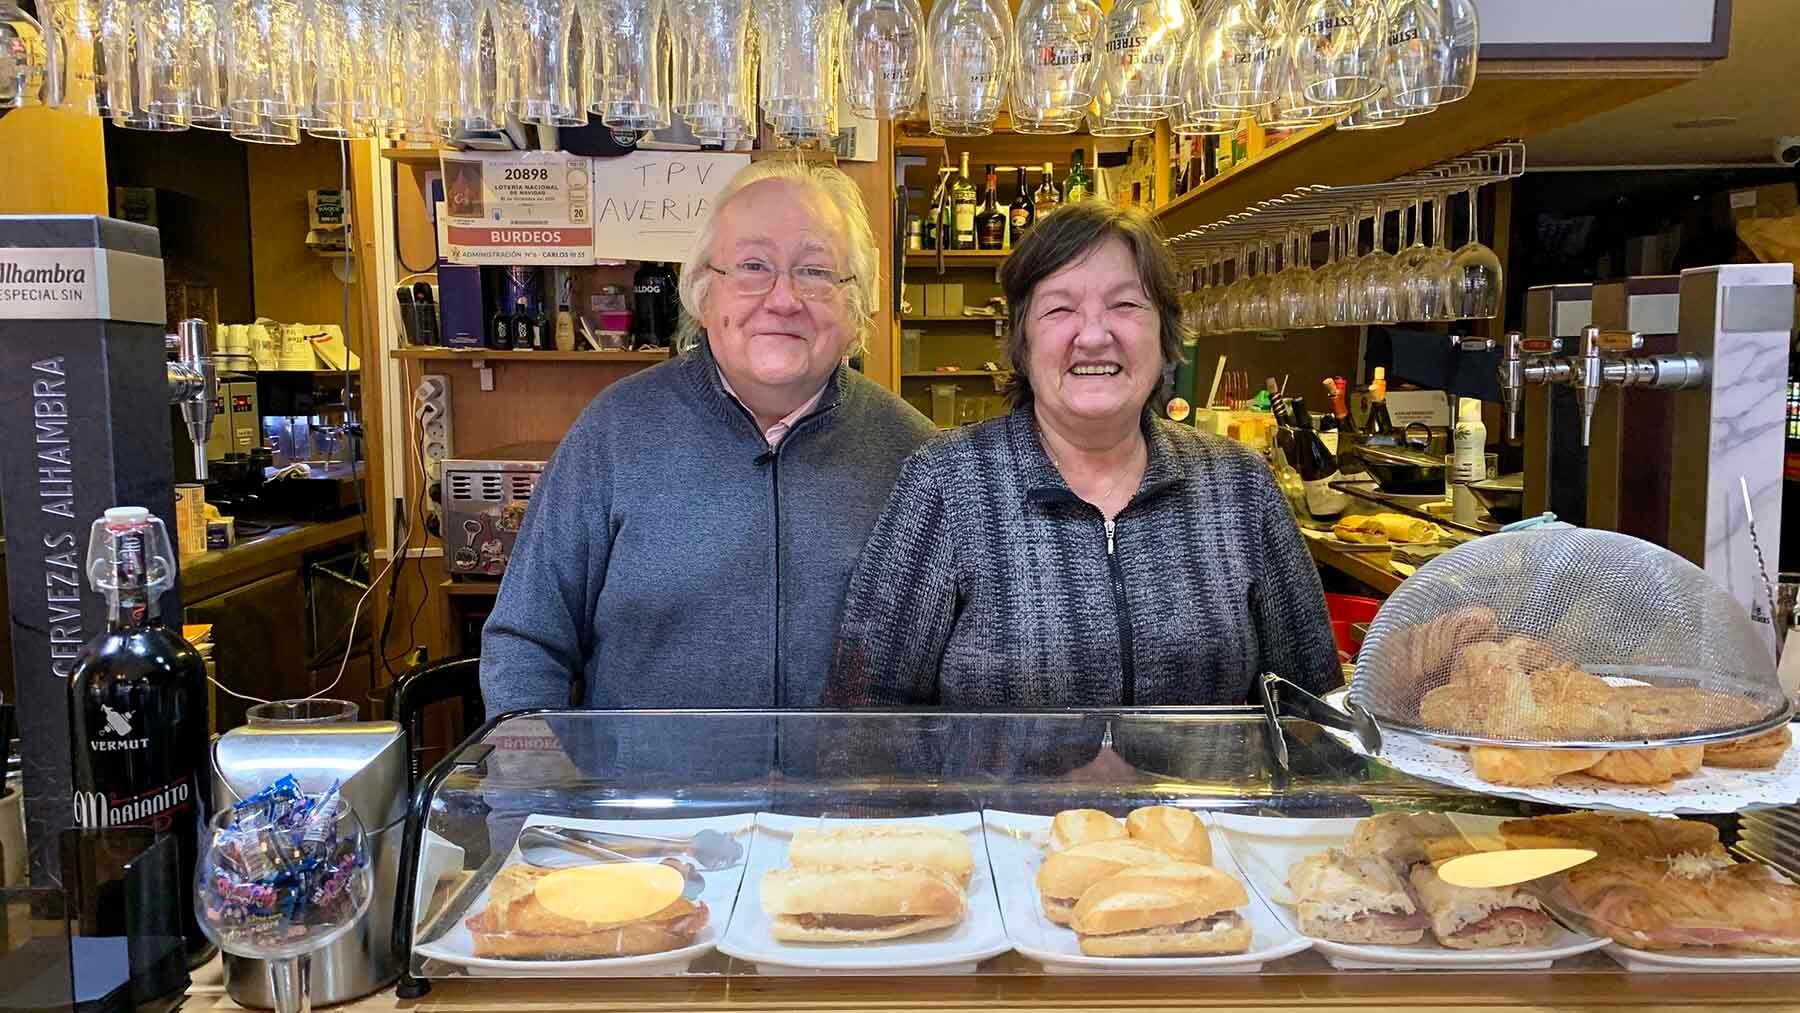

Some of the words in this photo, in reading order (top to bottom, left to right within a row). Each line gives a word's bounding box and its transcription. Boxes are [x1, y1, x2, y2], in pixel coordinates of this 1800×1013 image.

[504, 168, 548, 181] 20898
[573, 209, 584, 218] 20
[490, 231, 561, 243] BURDEOS
[462, 250, 522, 258] ADMINISTRACIÓN
[62, 289, 83, 300] SIN
[32, 356, 76, 519] ALHAMBRA
[45, 533, 82, 678] CERVEZAS
[91, 738, 149, 751] VERMUT
